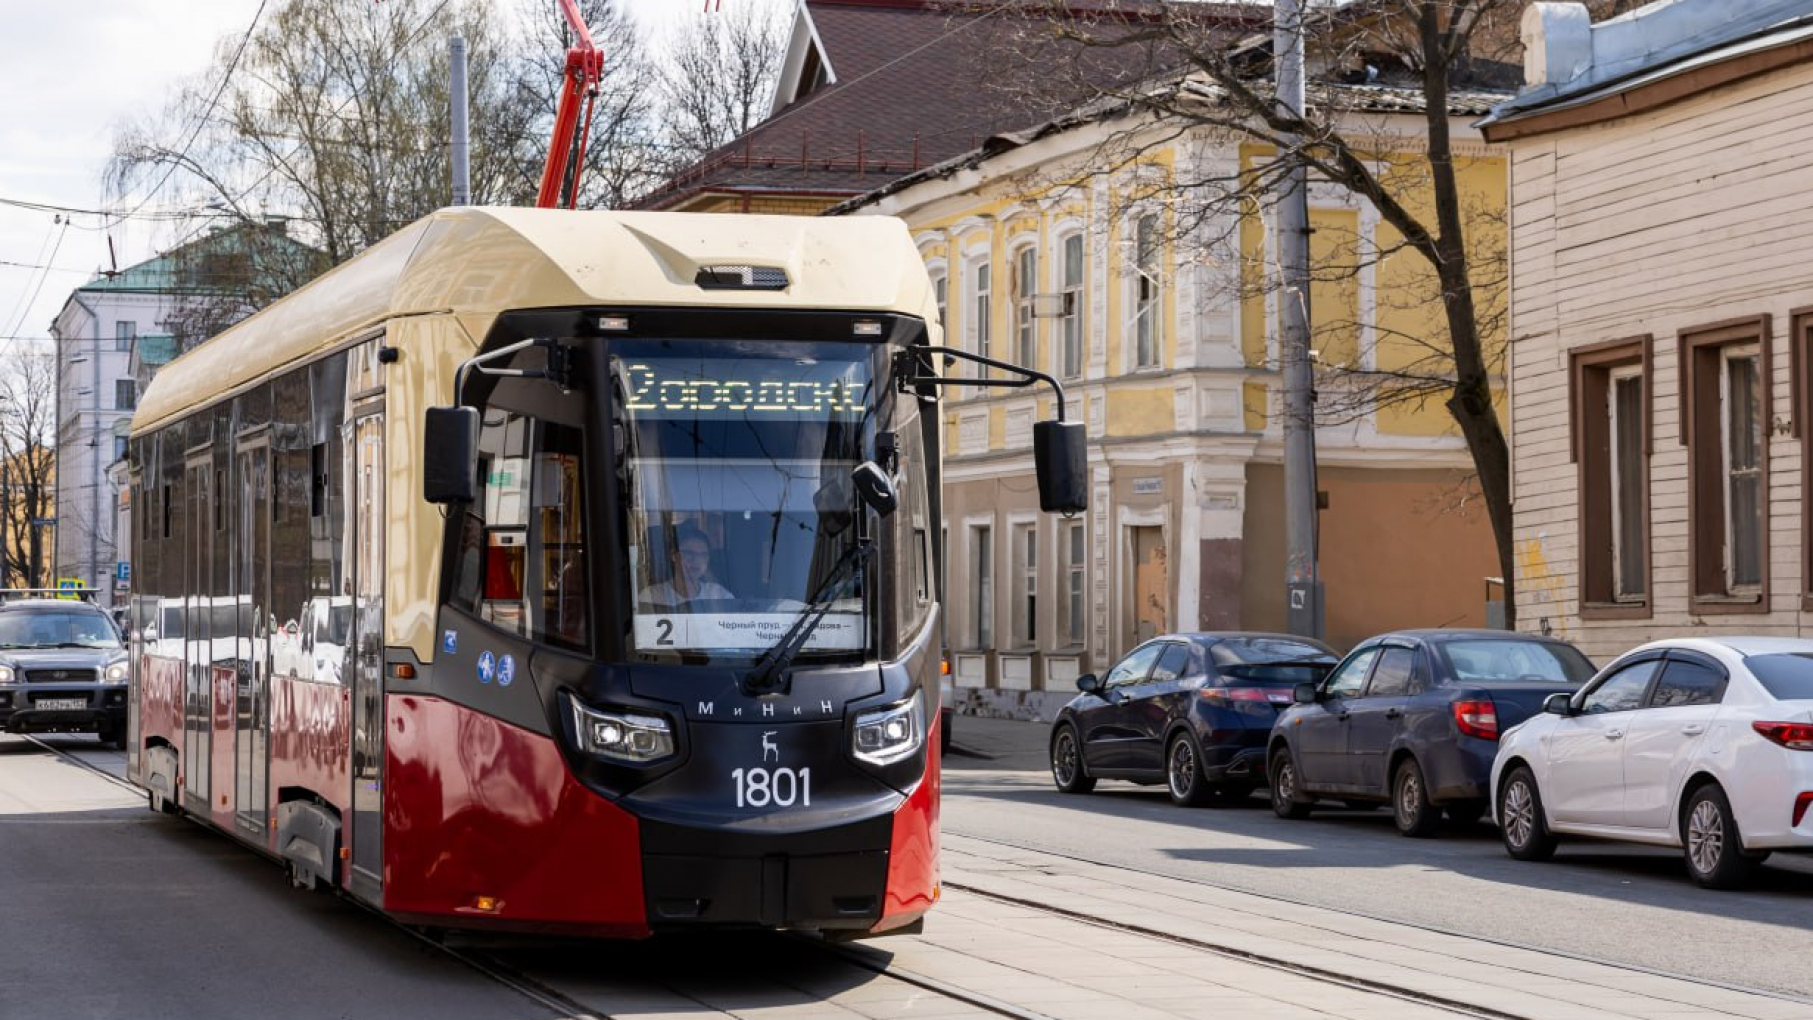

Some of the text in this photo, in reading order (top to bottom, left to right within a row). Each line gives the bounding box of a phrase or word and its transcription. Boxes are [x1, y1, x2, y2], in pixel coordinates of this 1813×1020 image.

[656, 619, 674, 645] 2
[718, 620, 756, 630] Черный
[731, 767, 811, 807] 1801
